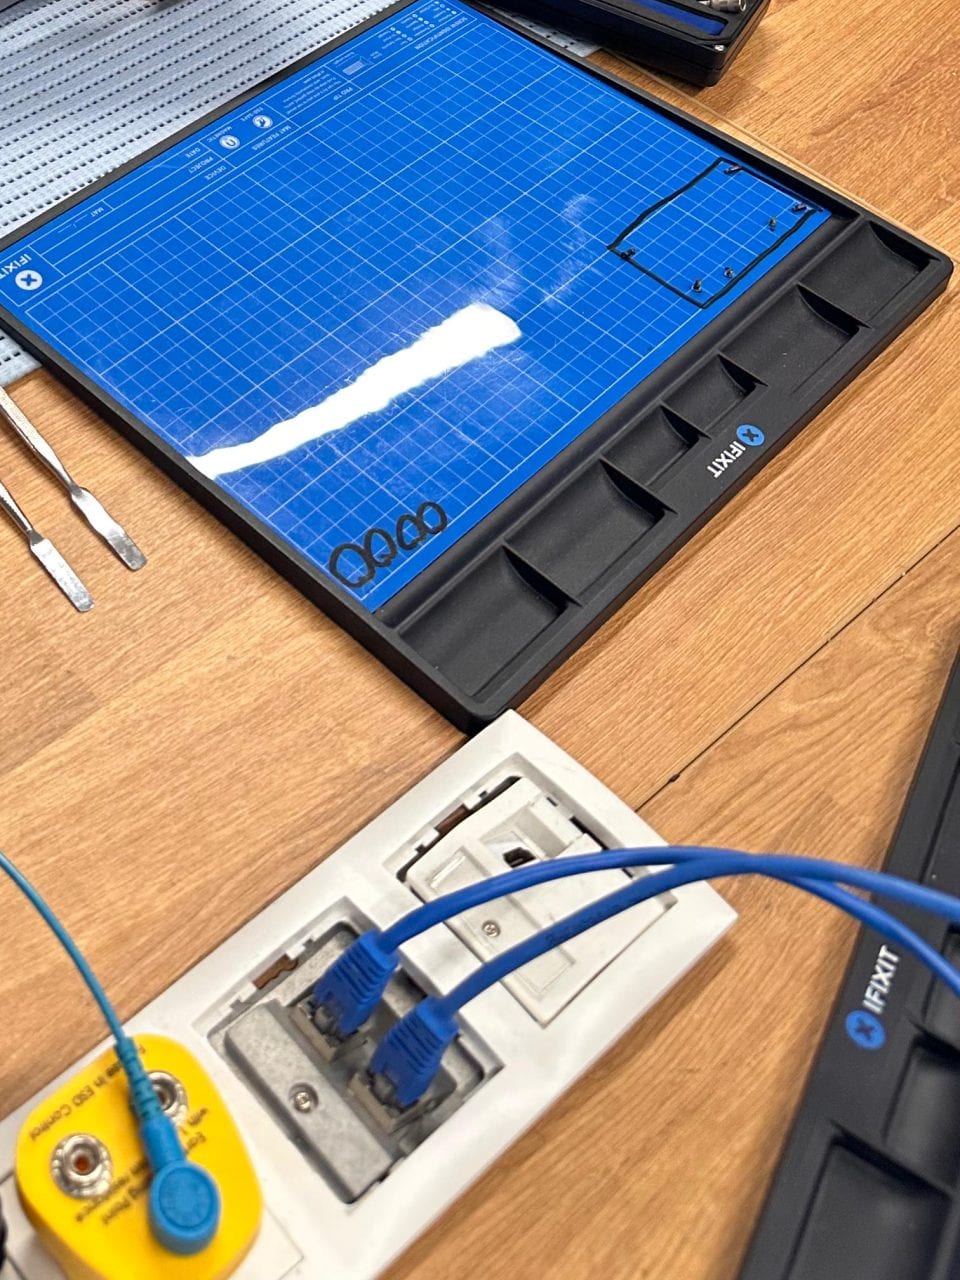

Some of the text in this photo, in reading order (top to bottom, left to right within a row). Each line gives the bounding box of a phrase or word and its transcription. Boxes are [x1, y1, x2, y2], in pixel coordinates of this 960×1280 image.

[707, 441, 746, 478] IFIXIT
[862, 944, 899, 1014] IFIXIT
[30, 1103, 72, 1142] Control
